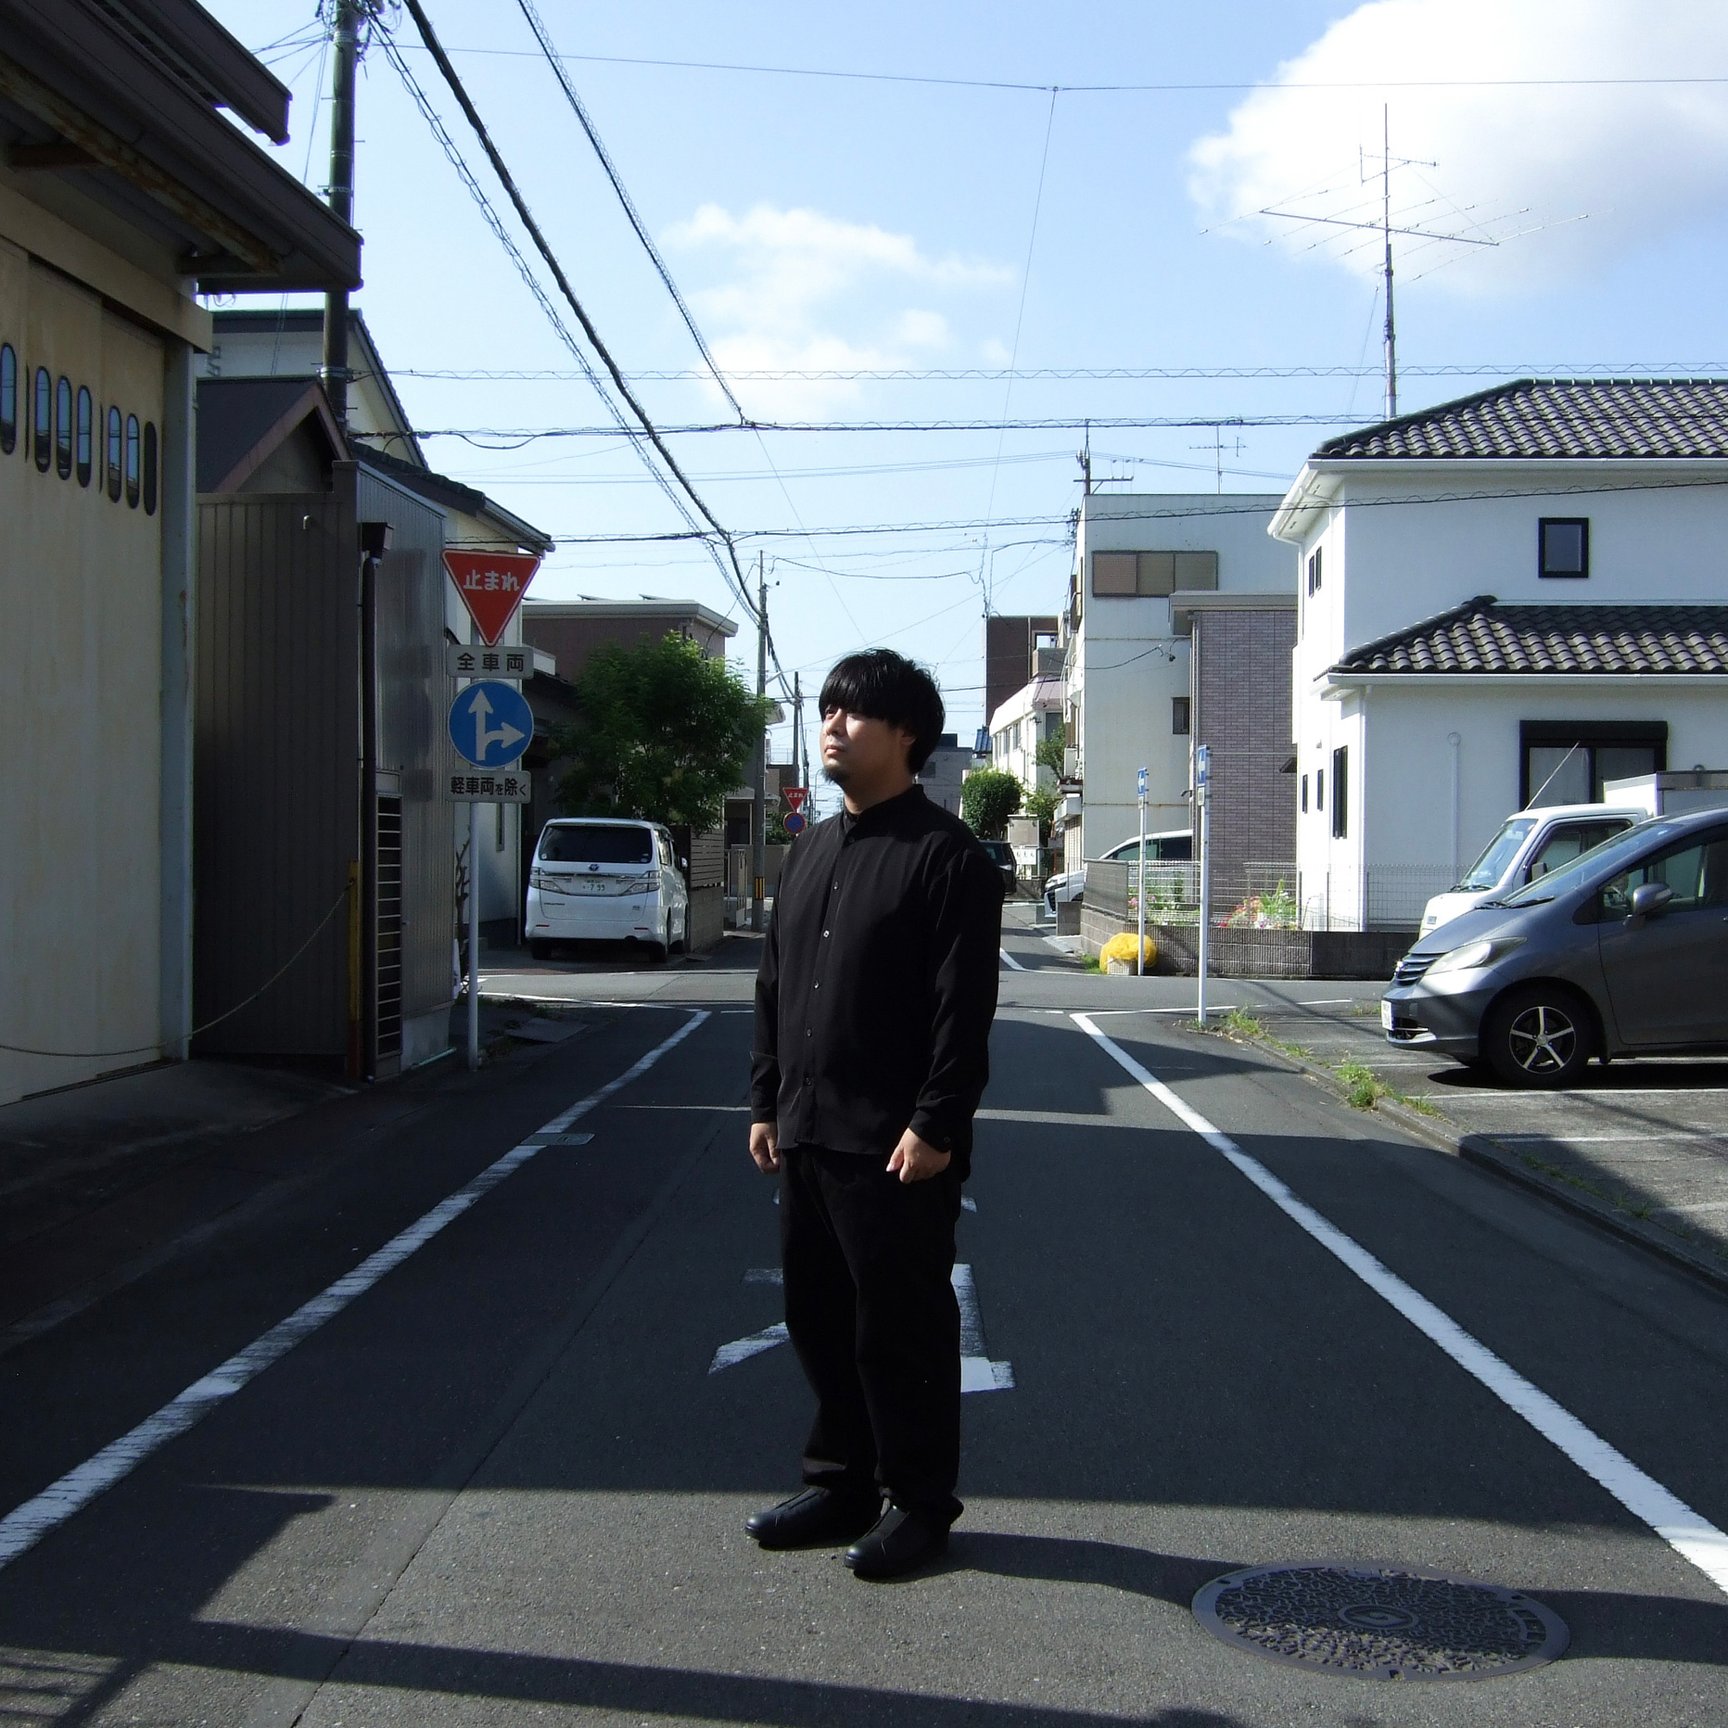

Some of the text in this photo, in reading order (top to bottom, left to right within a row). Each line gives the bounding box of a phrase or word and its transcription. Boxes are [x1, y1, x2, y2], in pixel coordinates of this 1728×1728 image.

[463, 569, 521, 592] 止まれ
[457, 652, 525, 672] 全車両
[450, 776, 527, 796] 軽車両を除く
